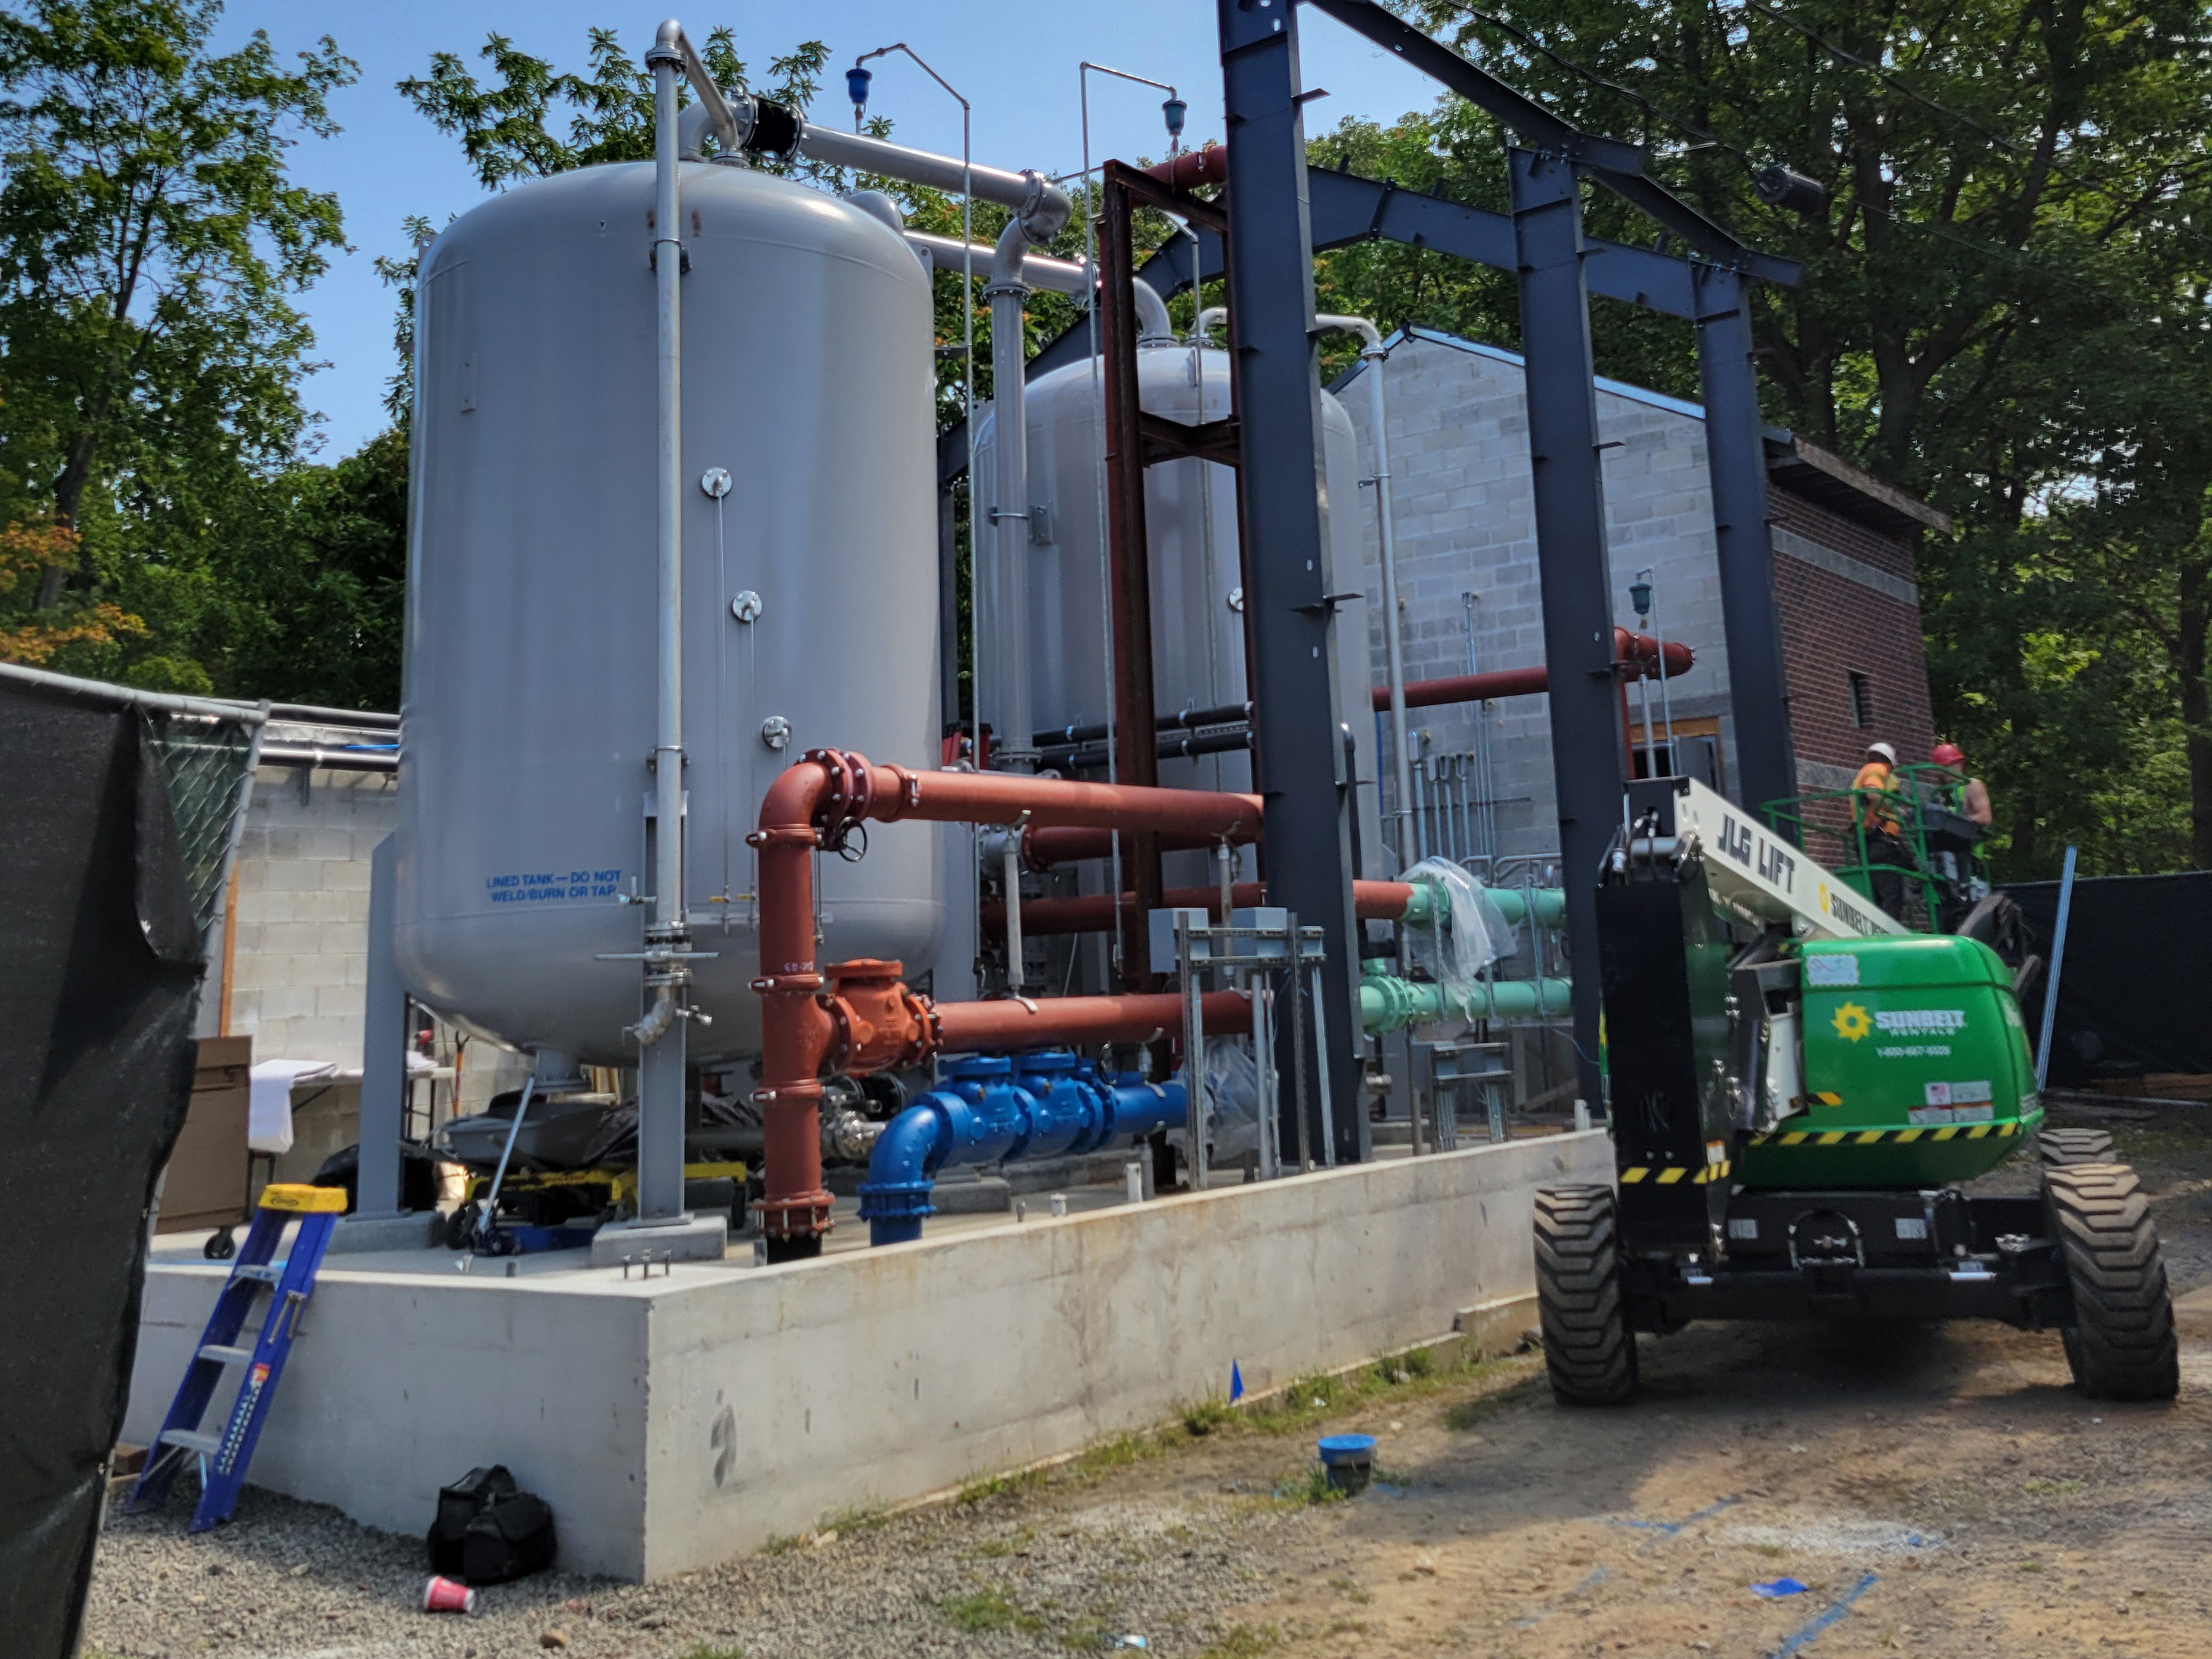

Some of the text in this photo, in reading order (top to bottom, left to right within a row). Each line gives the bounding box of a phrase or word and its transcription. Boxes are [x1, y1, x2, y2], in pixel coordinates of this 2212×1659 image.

[1717, 812, 1794, 895] JLG LIFT
[486, 875, 520, 888] LINED
[522, 873, 554, 886] TANK
[571, 870, 590, 884] DO
[594, 869, 621, 882] NOT
[569, 885, 588, 898] OR
[591, 884, 617, 897] TAP
[1830, 892, 1871, 936] SUNBELT
[1874, 1009, 1964, 1029] SUNBELT
